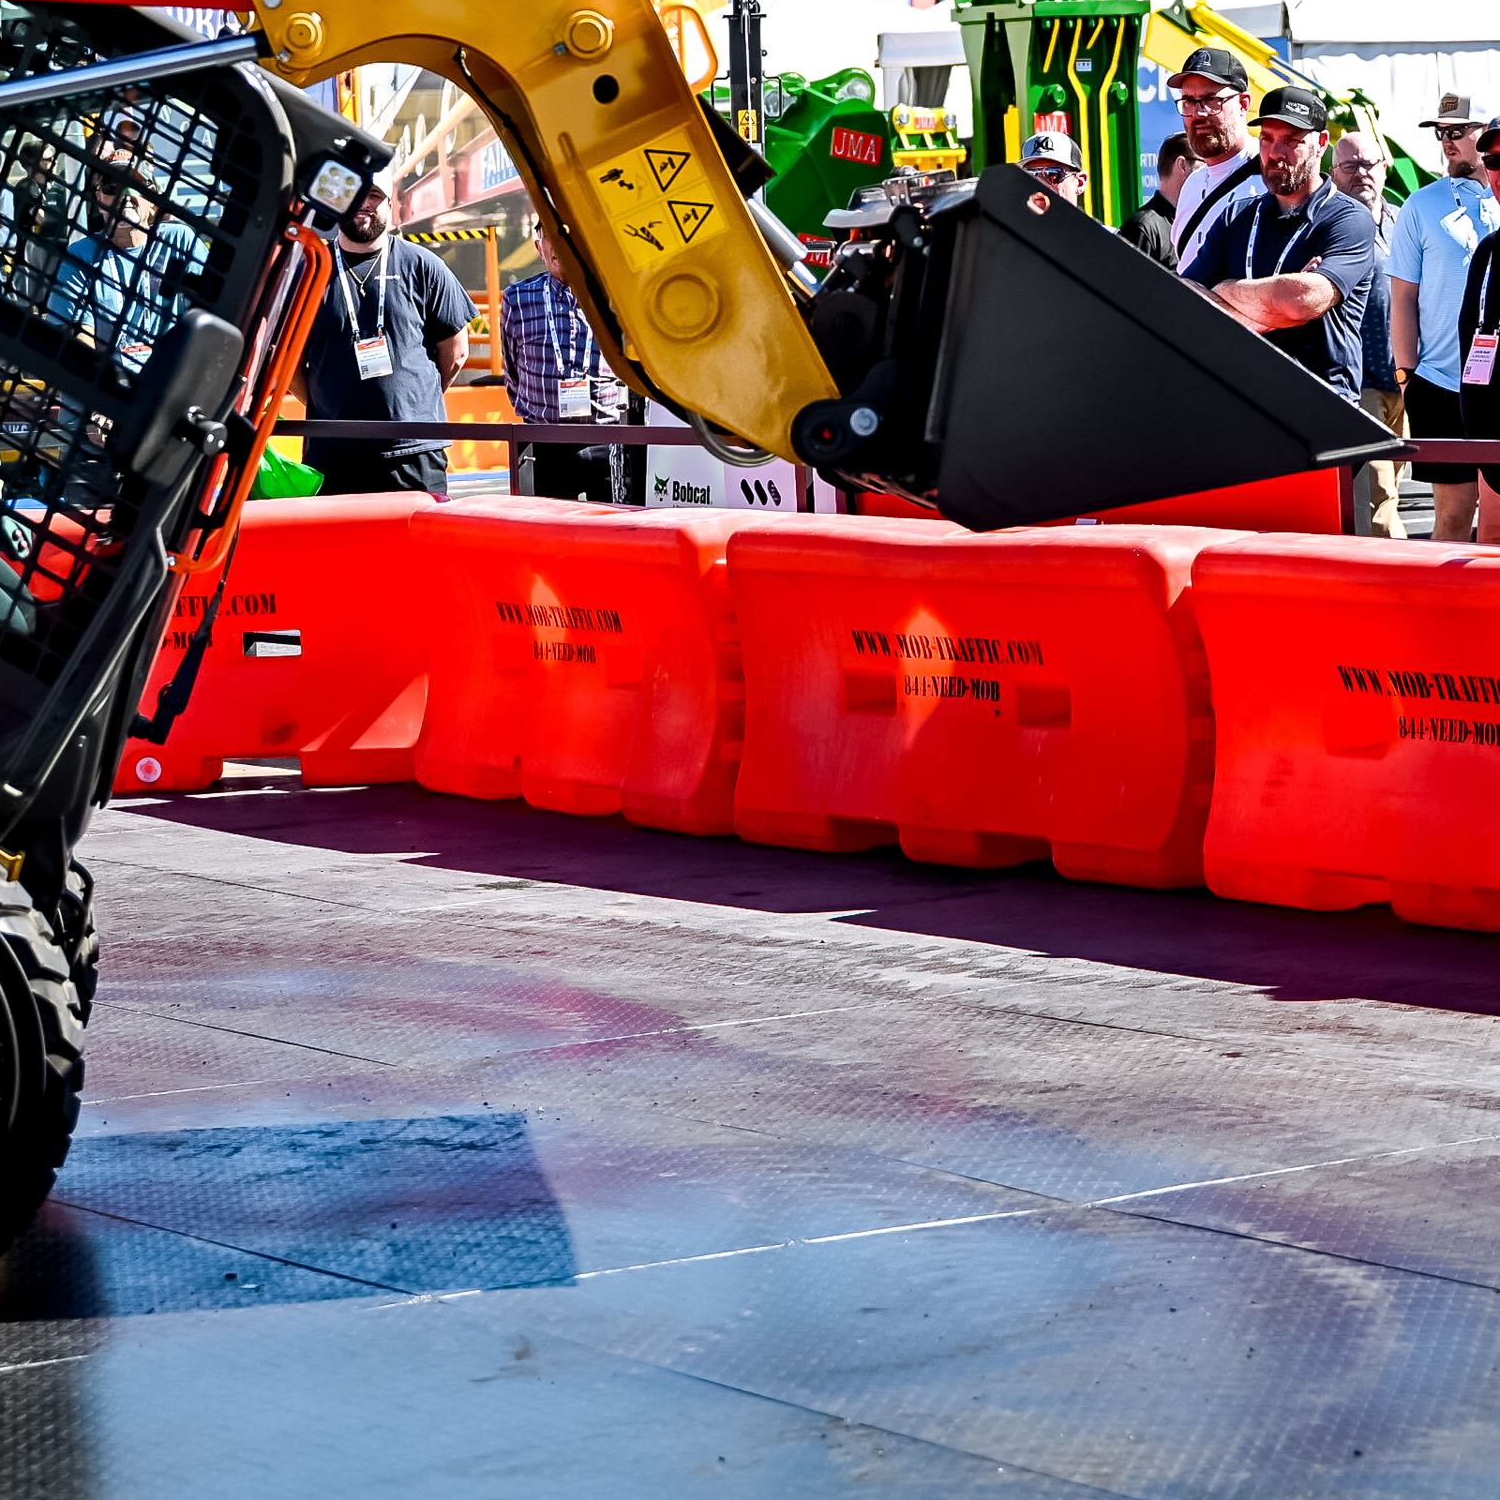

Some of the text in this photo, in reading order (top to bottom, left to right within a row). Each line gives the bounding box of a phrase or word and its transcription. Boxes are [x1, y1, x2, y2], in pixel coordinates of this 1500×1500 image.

[916, 116, 935, 129] JMA
[833, 132, 877, 164] JMA
[672, 481, 711, 505] Bobcat
[496, 601, 623, 633] WWW.MOB-TRAFFIC.COM
[533, 640, 596, 664] 844-NEED-MOB
[852, 629, 1045, 667] WWW.MOB-TRAFFIC.COM
[904, 675, 1000, 702] 844-NEED-MOB
